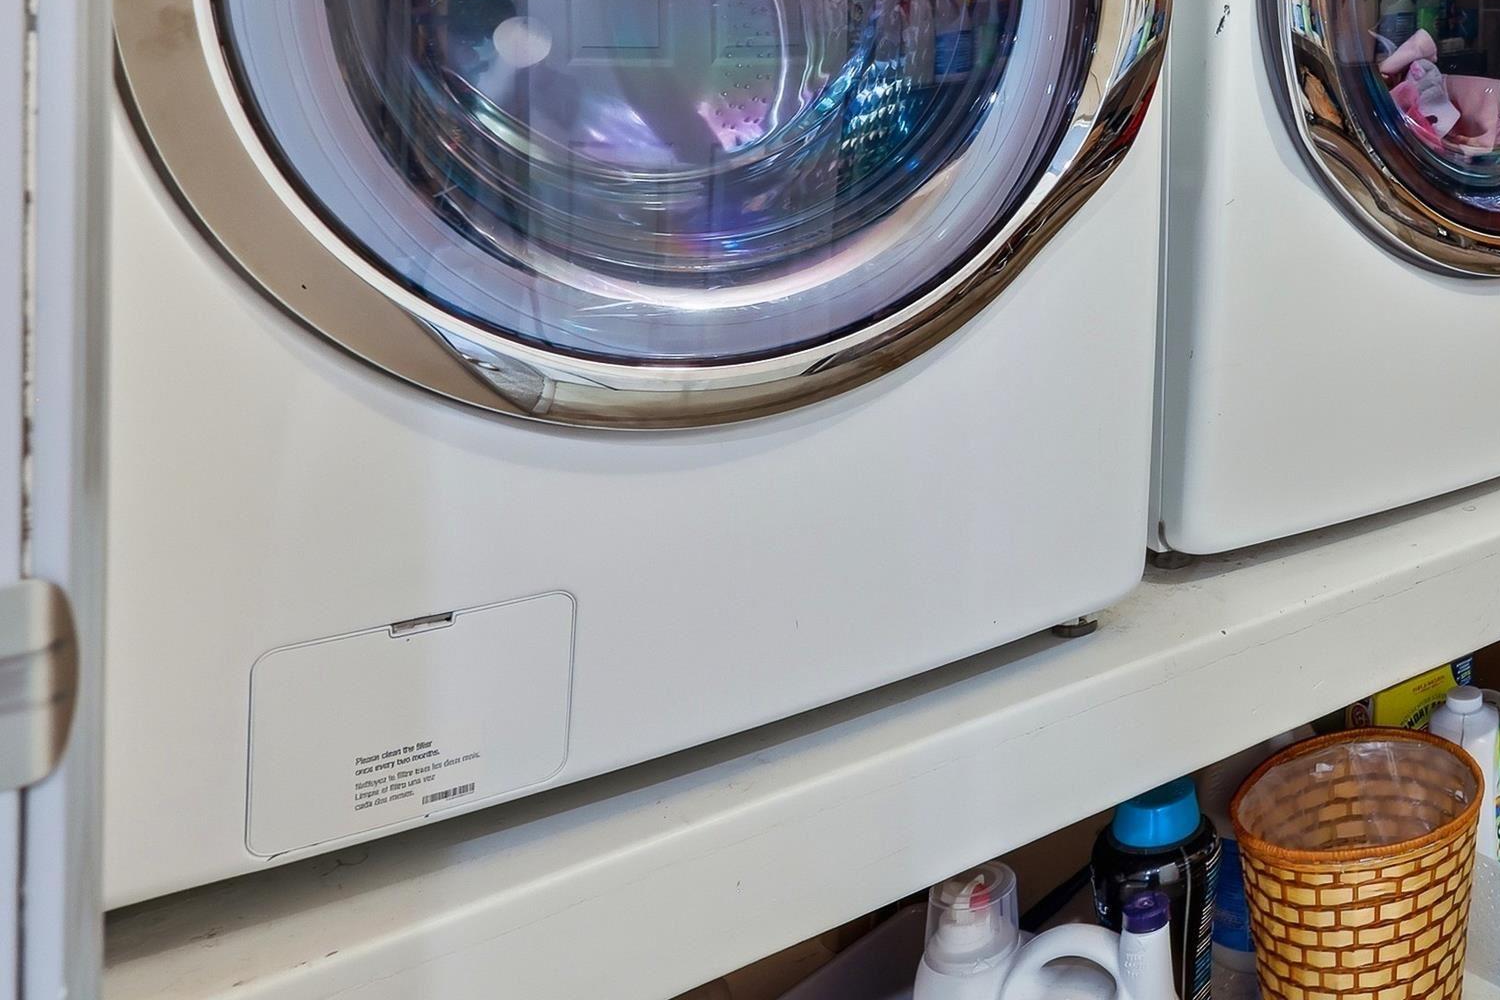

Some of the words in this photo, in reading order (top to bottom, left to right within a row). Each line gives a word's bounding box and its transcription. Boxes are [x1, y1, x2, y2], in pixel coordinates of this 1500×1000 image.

[355, 753, 380, 765] Please
[381, 749, 401, 759] clean
[402, 745, 414, 754] the
[416, 740, 432, 750] filter
[355, 766, 373, 776] once
[375, 760, 395, 772] every
[397, 756, 411, 765] two
